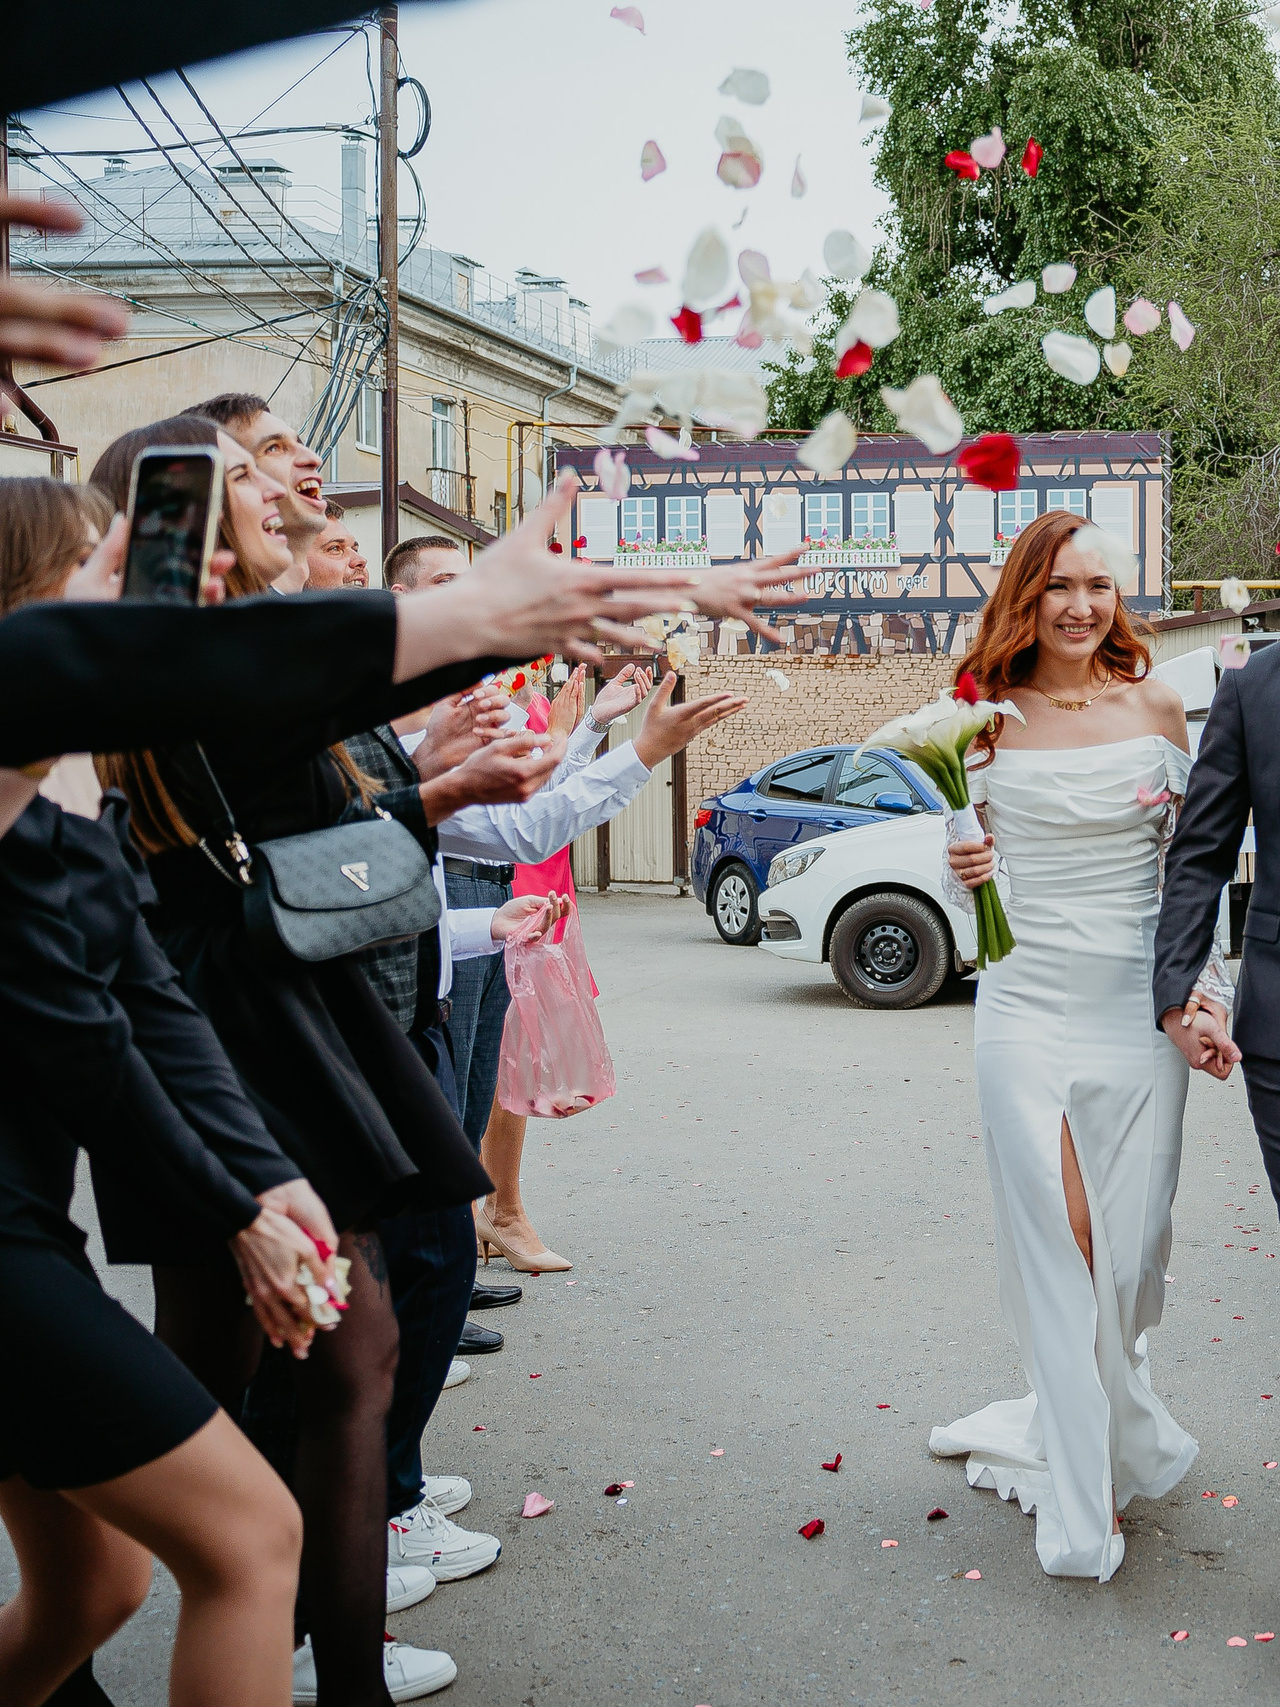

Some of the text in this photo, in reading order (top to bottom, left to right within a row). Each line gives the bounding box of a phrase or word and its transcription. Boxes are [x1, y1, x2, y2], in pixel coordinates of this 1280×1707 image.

[803, 570, 888, 594] ПРЕСТИЖ
[896, 575, 929, 591] КАФЕ
[1049, 699, 1085, 711] AMORE
